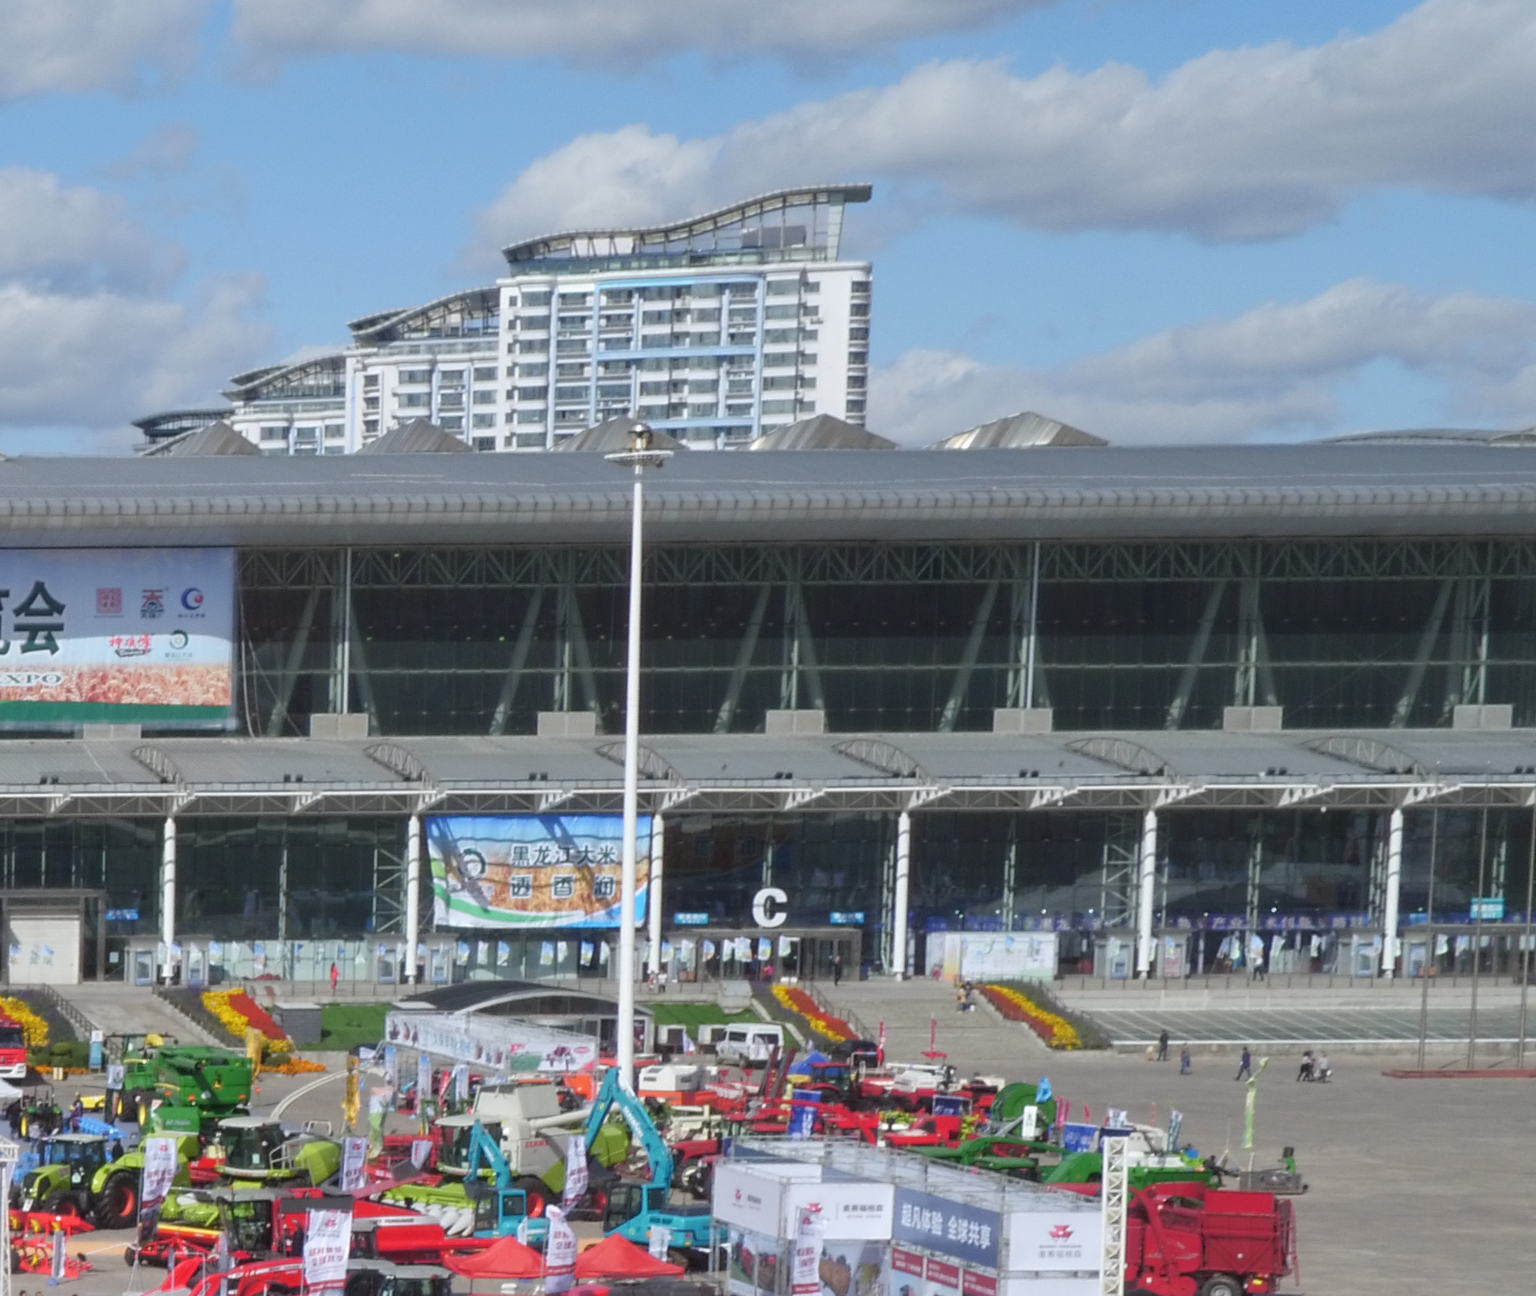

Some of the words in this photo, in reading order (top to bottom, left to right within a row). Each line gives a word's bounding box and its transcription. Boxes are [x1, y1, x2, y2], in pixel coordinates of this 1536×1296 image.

[512, 846, 617, 866] 黑龙江大米
[752, 887, 788, 928] C
[902, 1203, 942, 1235] 超凡体验
[947, 1216, 992, 1249] 全球共享
